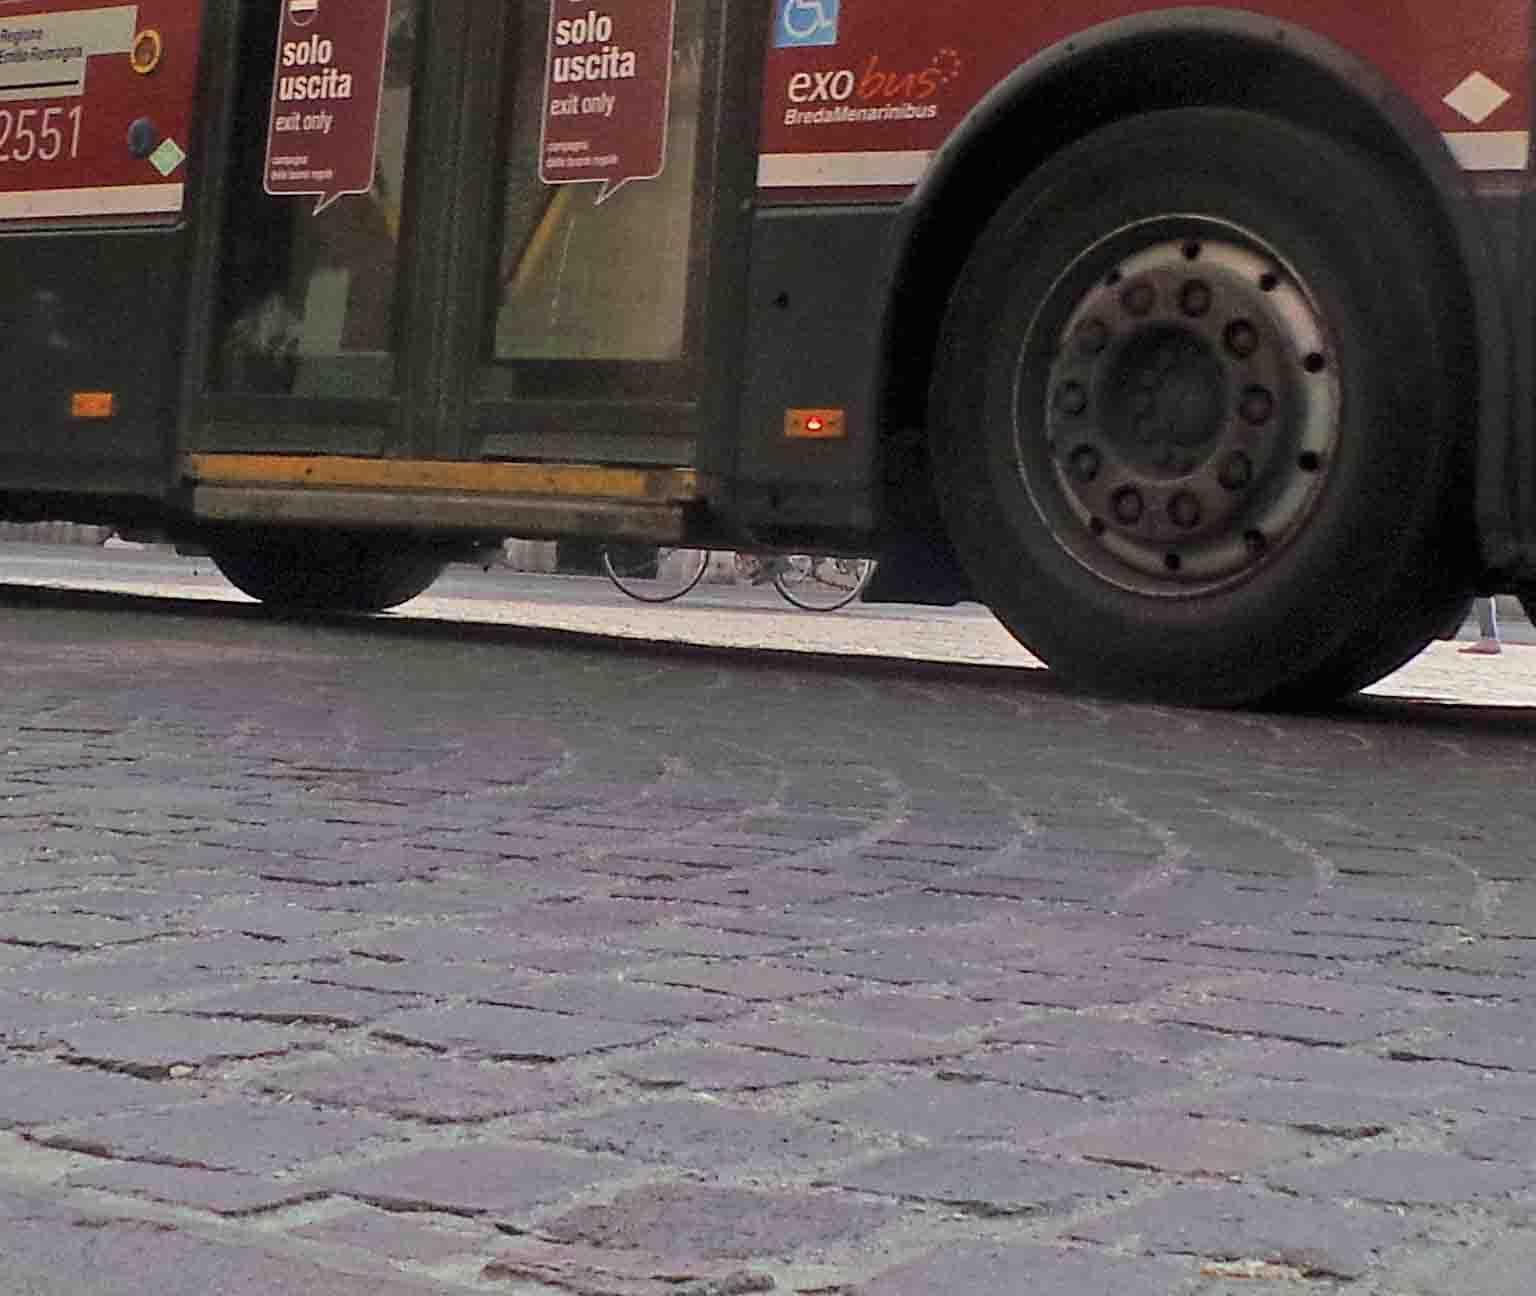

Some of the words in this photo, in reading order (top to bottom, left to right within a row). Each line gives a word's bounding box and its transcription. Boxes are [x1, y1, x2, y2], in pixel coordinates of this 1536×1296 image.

[555, 9, 613, 47] solo
[282, 33, 333, 67] solo
[552, 45, 638, 84] uscita
[278, 67, 354, 102] uscita
[275, 111, 302, 133] exit
[302, 107, 334, 135] only
[550, 93, 579, 117] exit
[580, 91, 616, 118] only
